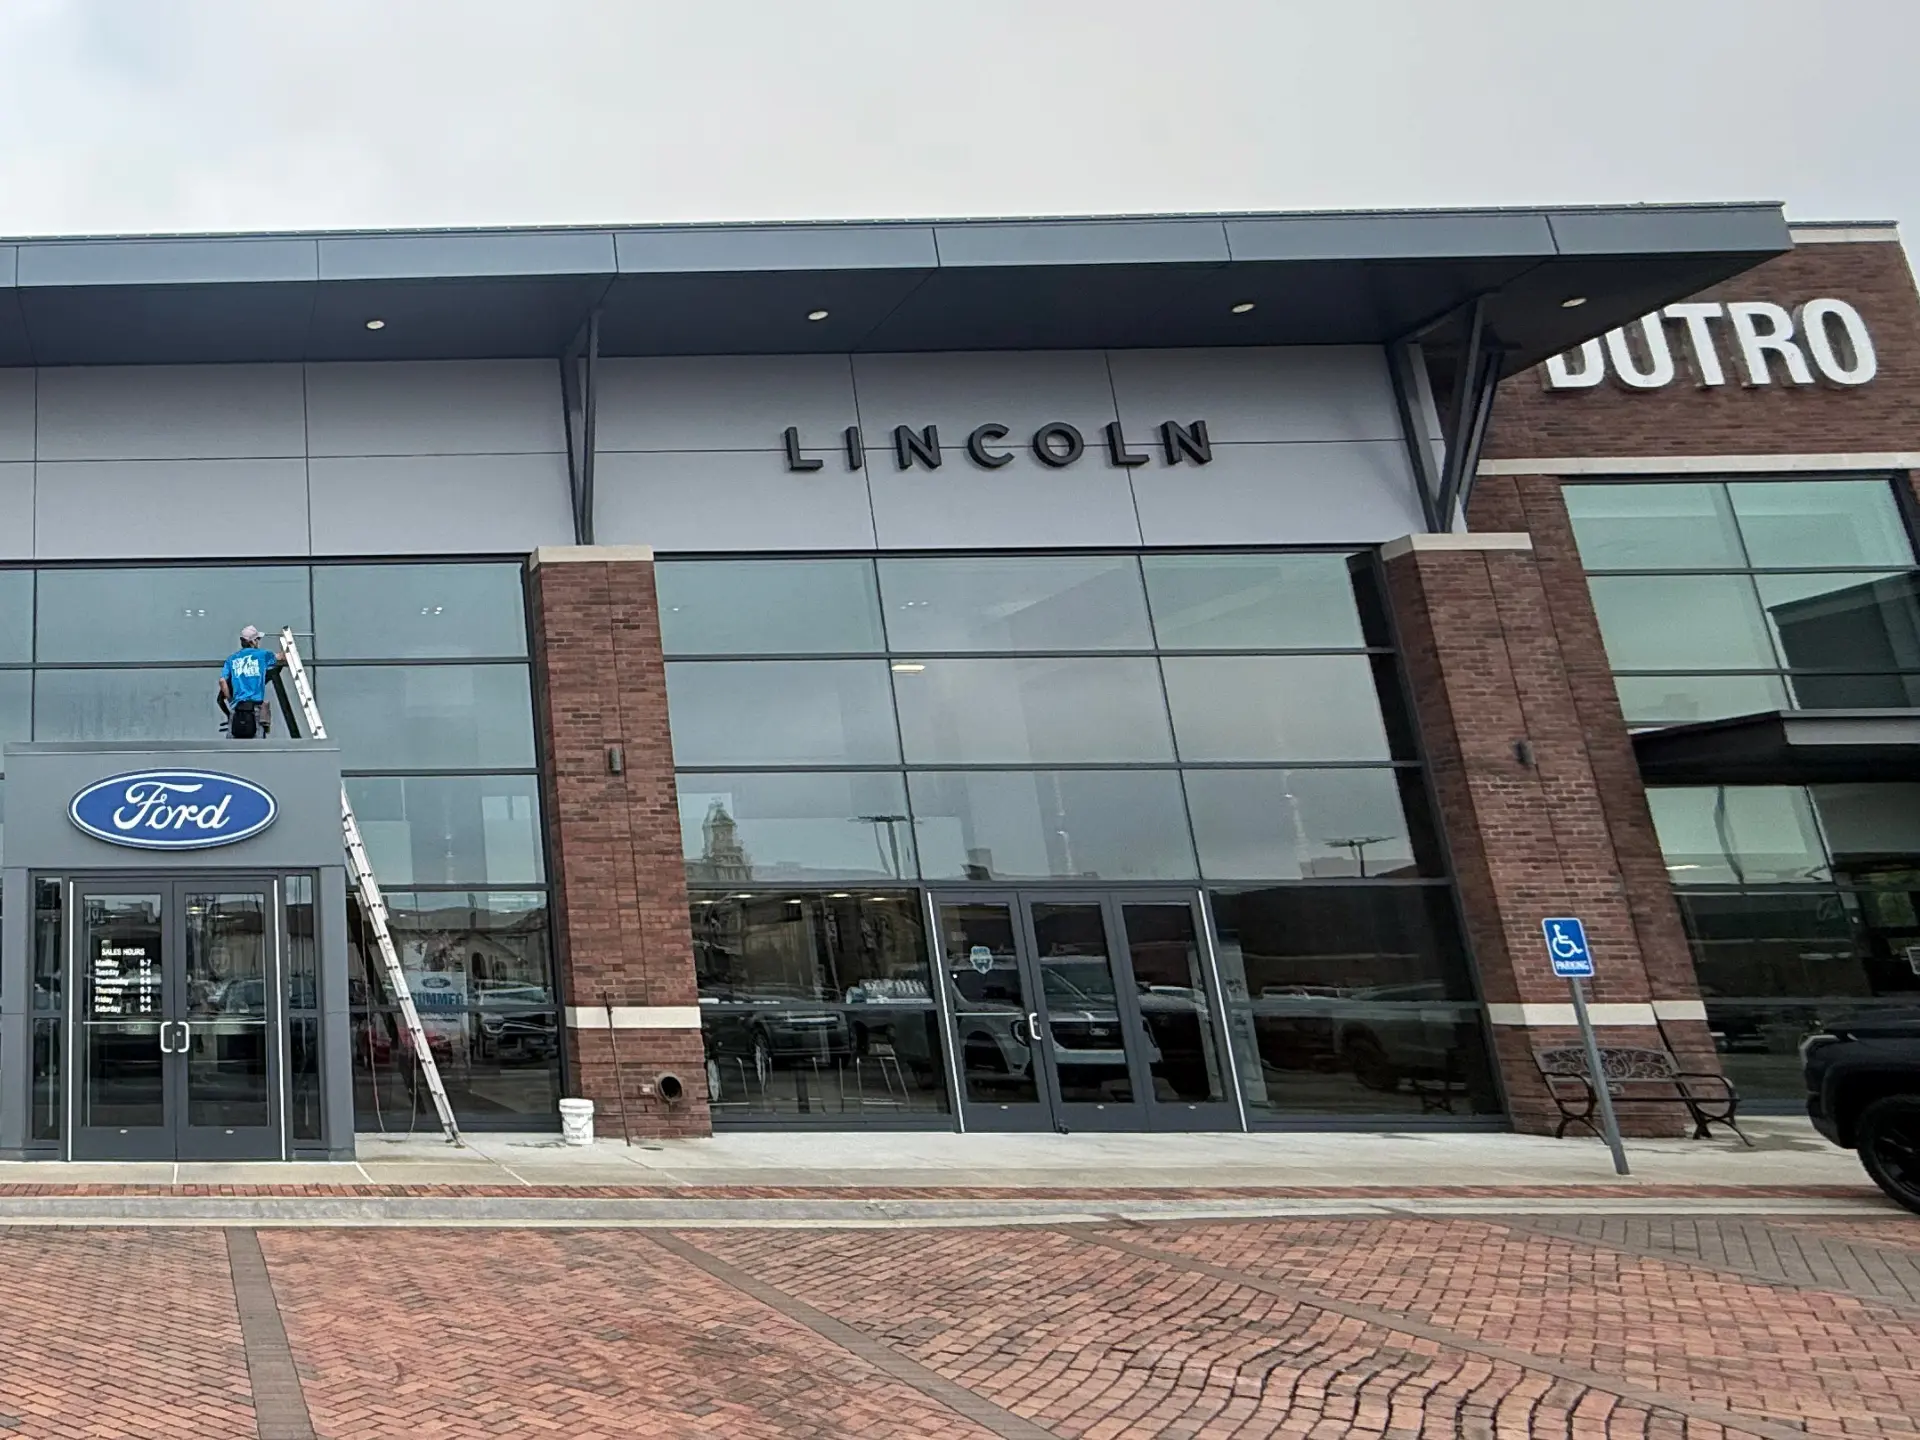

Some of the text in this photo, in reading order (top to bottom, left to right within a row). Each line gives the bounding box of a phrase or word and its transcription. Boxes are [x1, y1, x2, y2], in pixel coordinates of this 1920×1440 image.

[784, 419, 1212, 472] LINCOLN
[112, 781, 233, 831] Ford
[101, 948, 145, 956] SALES HOURS
[1555, 960, 1590, 970] PARKING
[95, 968, 119, 977] Tuesday
[95, 986, 122, 995] Thursday
[95, 995, 113, 1004] Friday
[95, 1004, 121, 1013] Saturday
